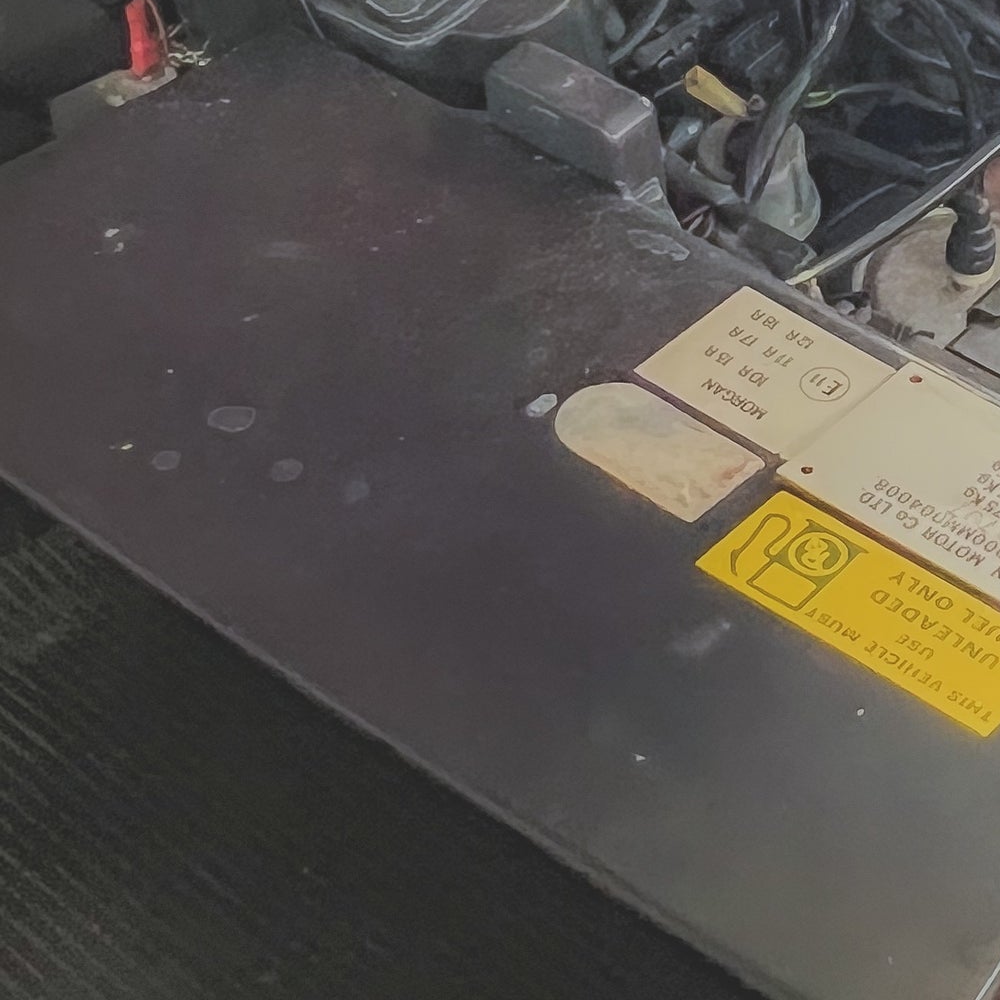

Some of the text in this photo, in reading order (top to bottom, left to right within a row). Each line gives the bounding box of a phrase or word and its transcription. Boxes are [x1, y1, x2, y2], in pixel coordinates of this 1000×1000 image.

[700, 378, 768, 421] MORGAN
[921, 526, 986, 567] MOTOR
[888, 570, 954, 611] ONLY
[869, 589, 1000, 670] UNLEADED
[894, 633, 935, 661] USE
[803, 607, 993, 723] THIS VEHICLE MUST
